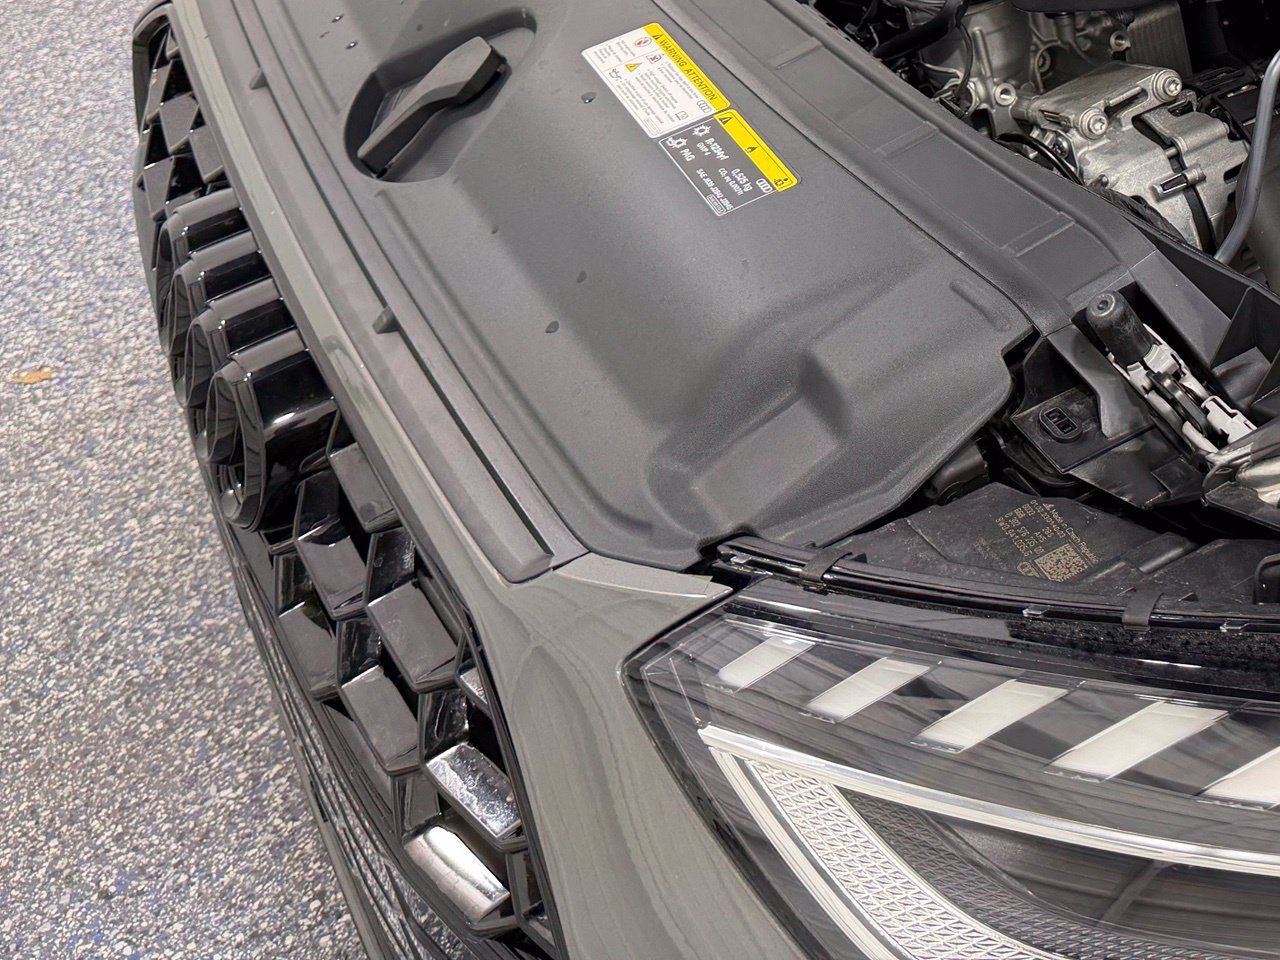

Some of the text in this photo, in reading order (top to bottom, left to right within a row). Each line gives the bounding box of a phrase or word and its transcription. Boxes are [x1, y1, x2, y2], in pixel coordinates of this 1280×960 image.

[659, 39, 687, 67] WARNING
[684, 68, 717, 101] ATTENTION
[680, 148, 695, 161] PAG
[696, 168, 707, 178] SAE
[705, 137, 729, 161] R-1234yf
[1051, 509, 1062, 522] Made
[1066, 527, 1080, 542] Czech
[1080, 541, 1099, 564] Republic
